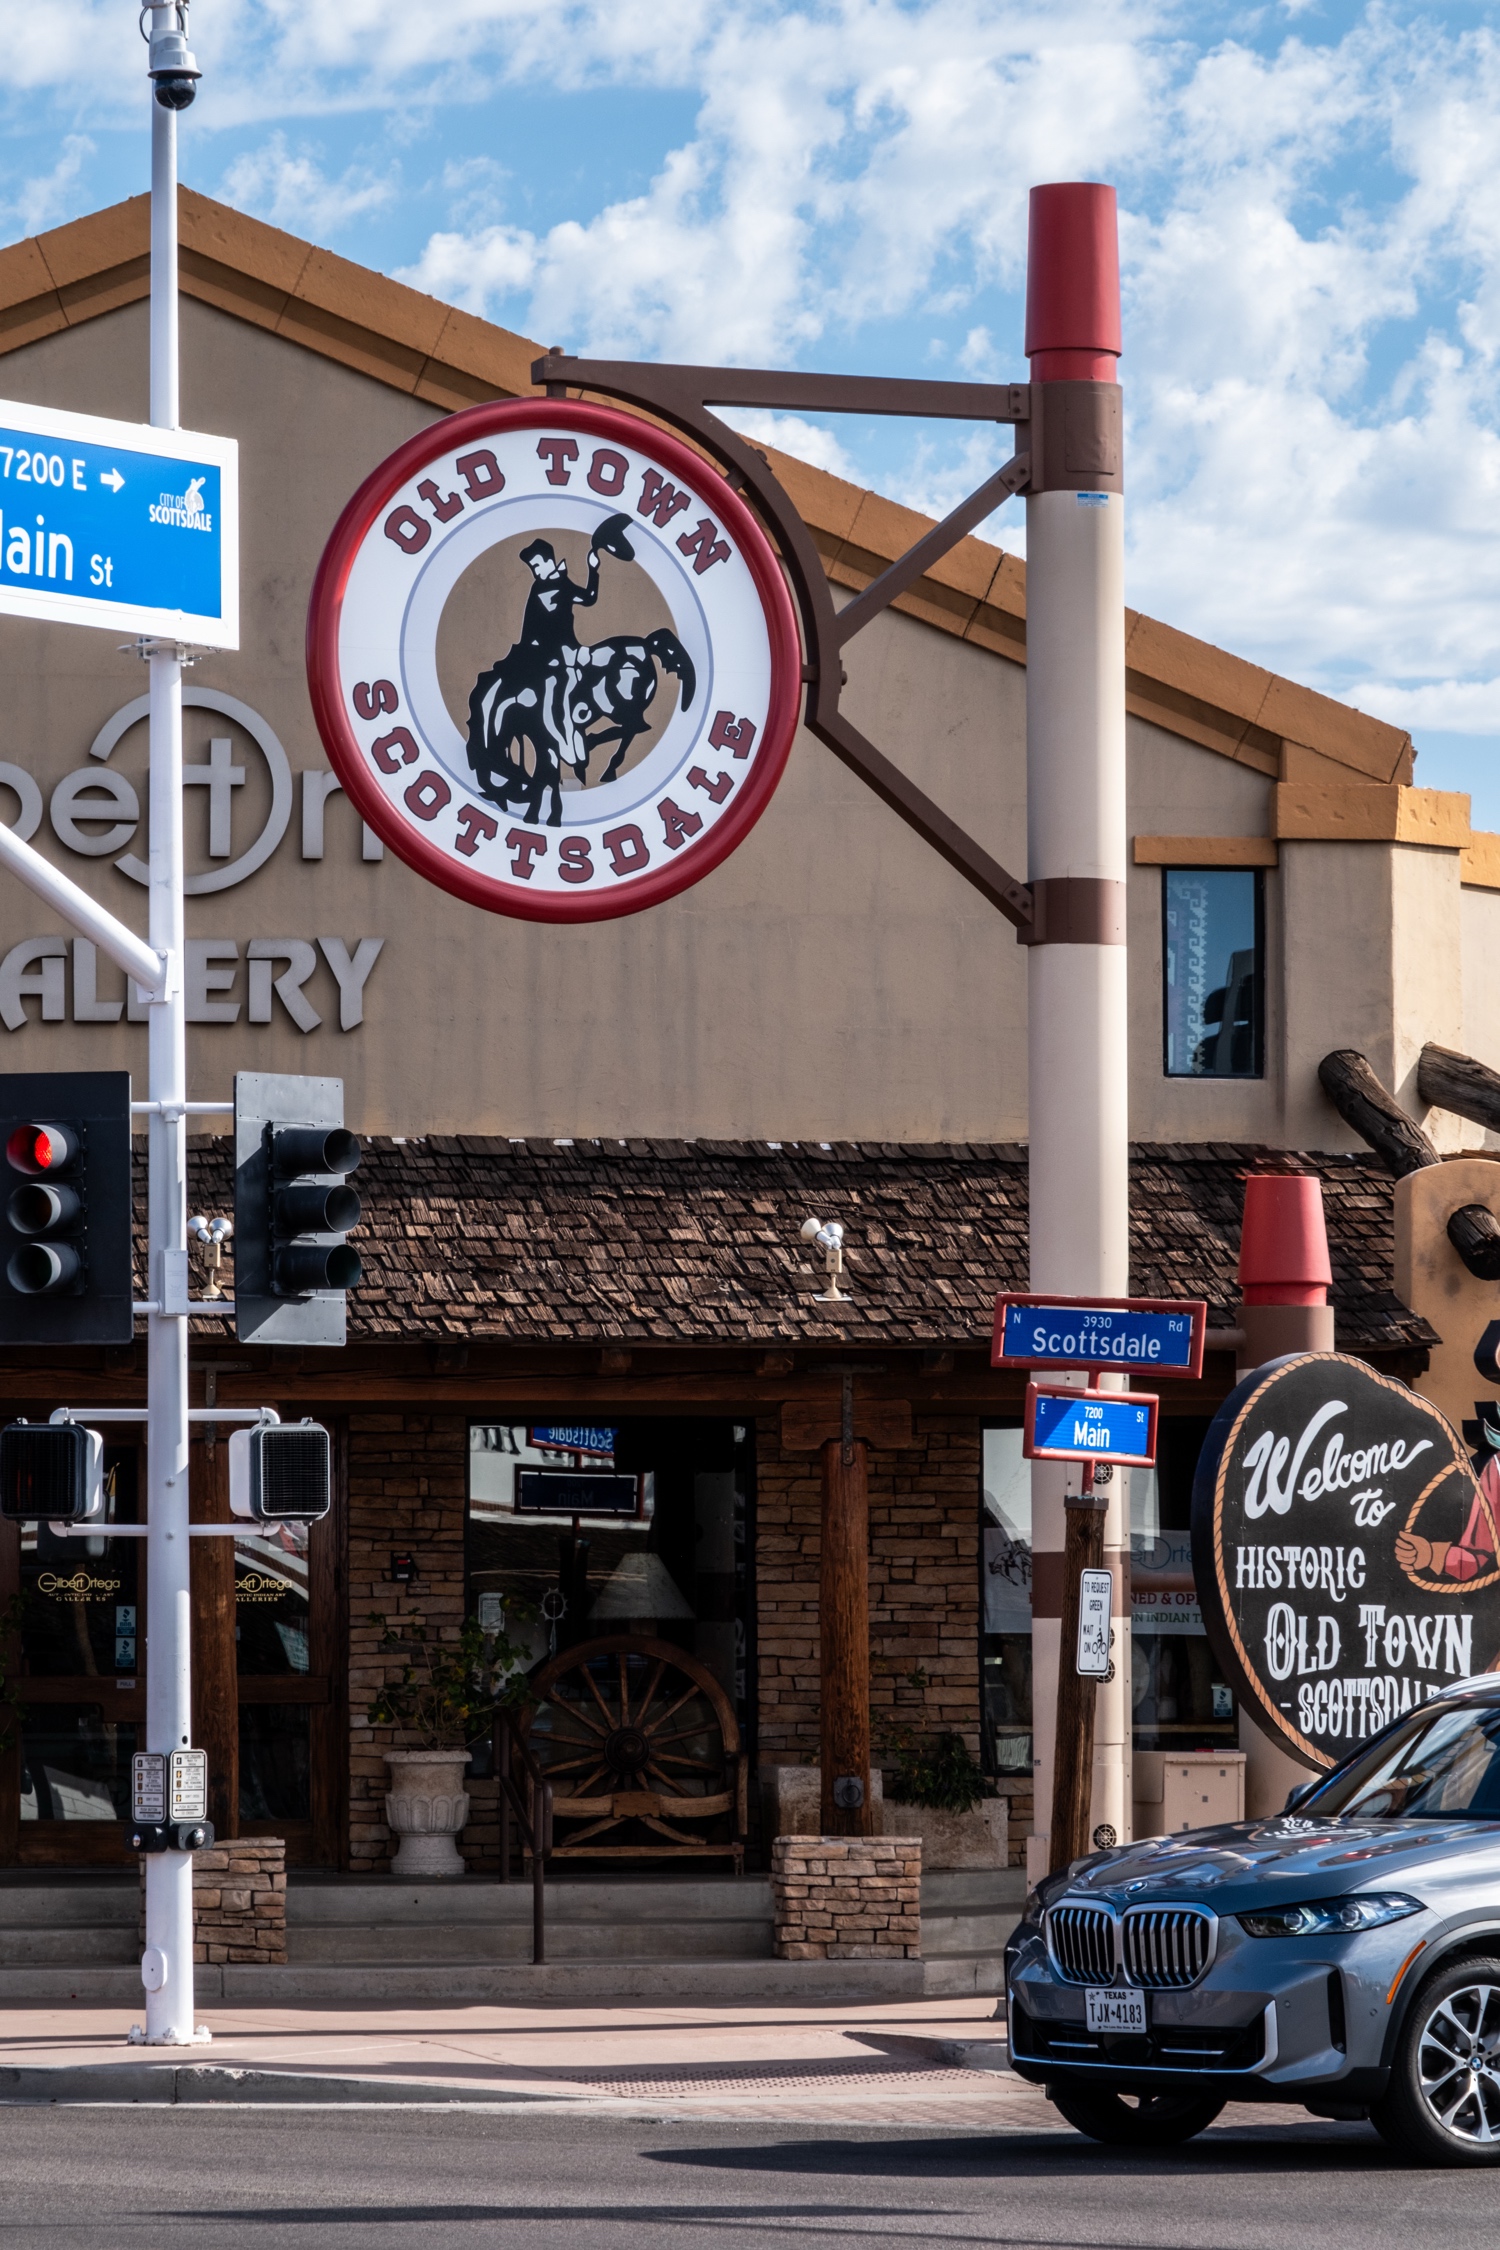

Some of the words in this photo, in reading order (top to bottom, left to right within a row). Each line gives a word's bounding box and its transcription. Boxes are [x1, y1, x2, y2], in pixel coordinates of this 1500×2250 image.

[0, 446, 65, 487] 7200
[72, 460, 87, 491] E
[159, 492, 174, 507] CITY
[175, 495, 185, 509] OF
[384, 449, 506, 554] OLD
[536, 437, 732, 575] TOWN
[149, 504, 212, 532] SCOTTSDALE
[0, 509, 74, 581] ain
[89, 554, 114, 588] St
[352, 679, 757, 883] SCOTTSDALE
[1013, 1313, 1021, 1324] N
[1083, 1316, 1112, 1328] 3930
[1168, 1320, 1183, 1332] Rd
[1032, 1327, 1161, 1359] Scottsdale
[1041, 1403, 1046, 1414] E
[1084, 1406, 1103, 1419] 7200
[1136, 1411, 1144, 1423] St
[1073, 1420, 1110, 1448] Main
[1242, 1400, 1434, 1520] Welcome
[1350, 1487, 1396, 1527] to
[1235, 1546, 1366, 1602] HISTORIC
[1085, 1582, 1090, 1592] TO
[1091, 1582, 1109, 1594] REQUEST
[1162, 1593, 1171, 1604] &
[1089, 1600, 1103, 1611] GREEN
[1083, 1624, 1094, 1635] WAIT
[1147, 1613, 1190, 1623] INDIAN
[1193, 1614, 1204, 1623] T
[1084, 1642, 1091, 1653] ON
[1104, 1991, 1127, 2000] TEXAS
